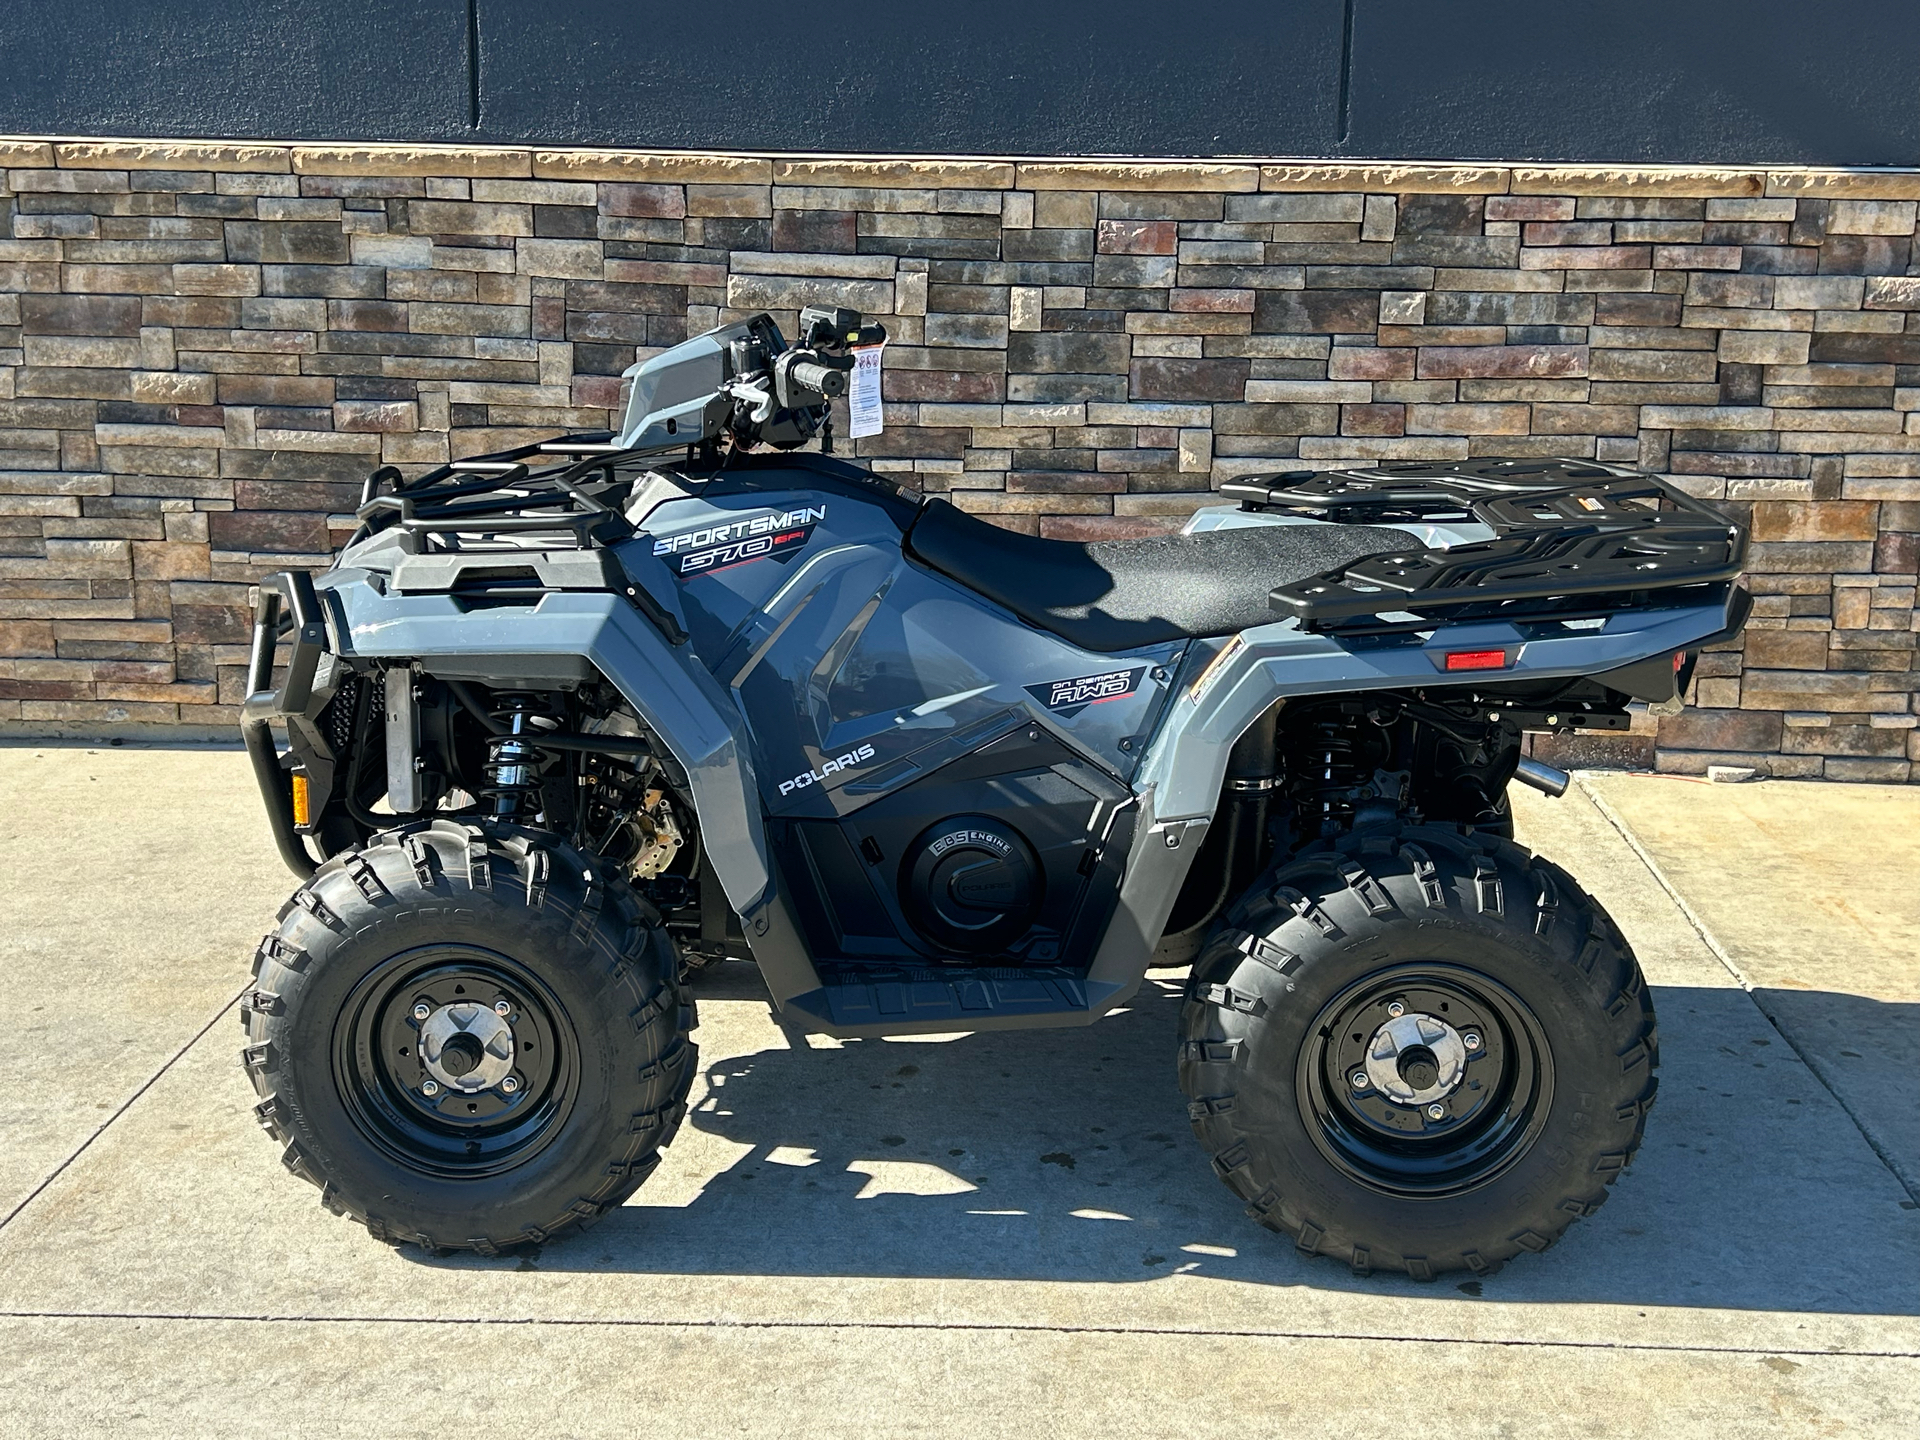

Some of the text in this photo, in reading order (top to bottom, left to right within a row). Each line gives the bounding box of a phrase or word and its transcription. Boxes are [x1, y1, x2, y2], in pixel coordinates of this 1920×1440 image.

[652, 504, 827, 557] SPORTSMAN
[680, 535, 773, 573] 570
[1050, 678, 1130, 705] AWD
[1052, 671, 1131, 690] ON DEMAND
[778, 743, 876, 796] POLARIS
[932, 831, 967, 854] EBS
[970, 831, 1012, 853] ENGINE
